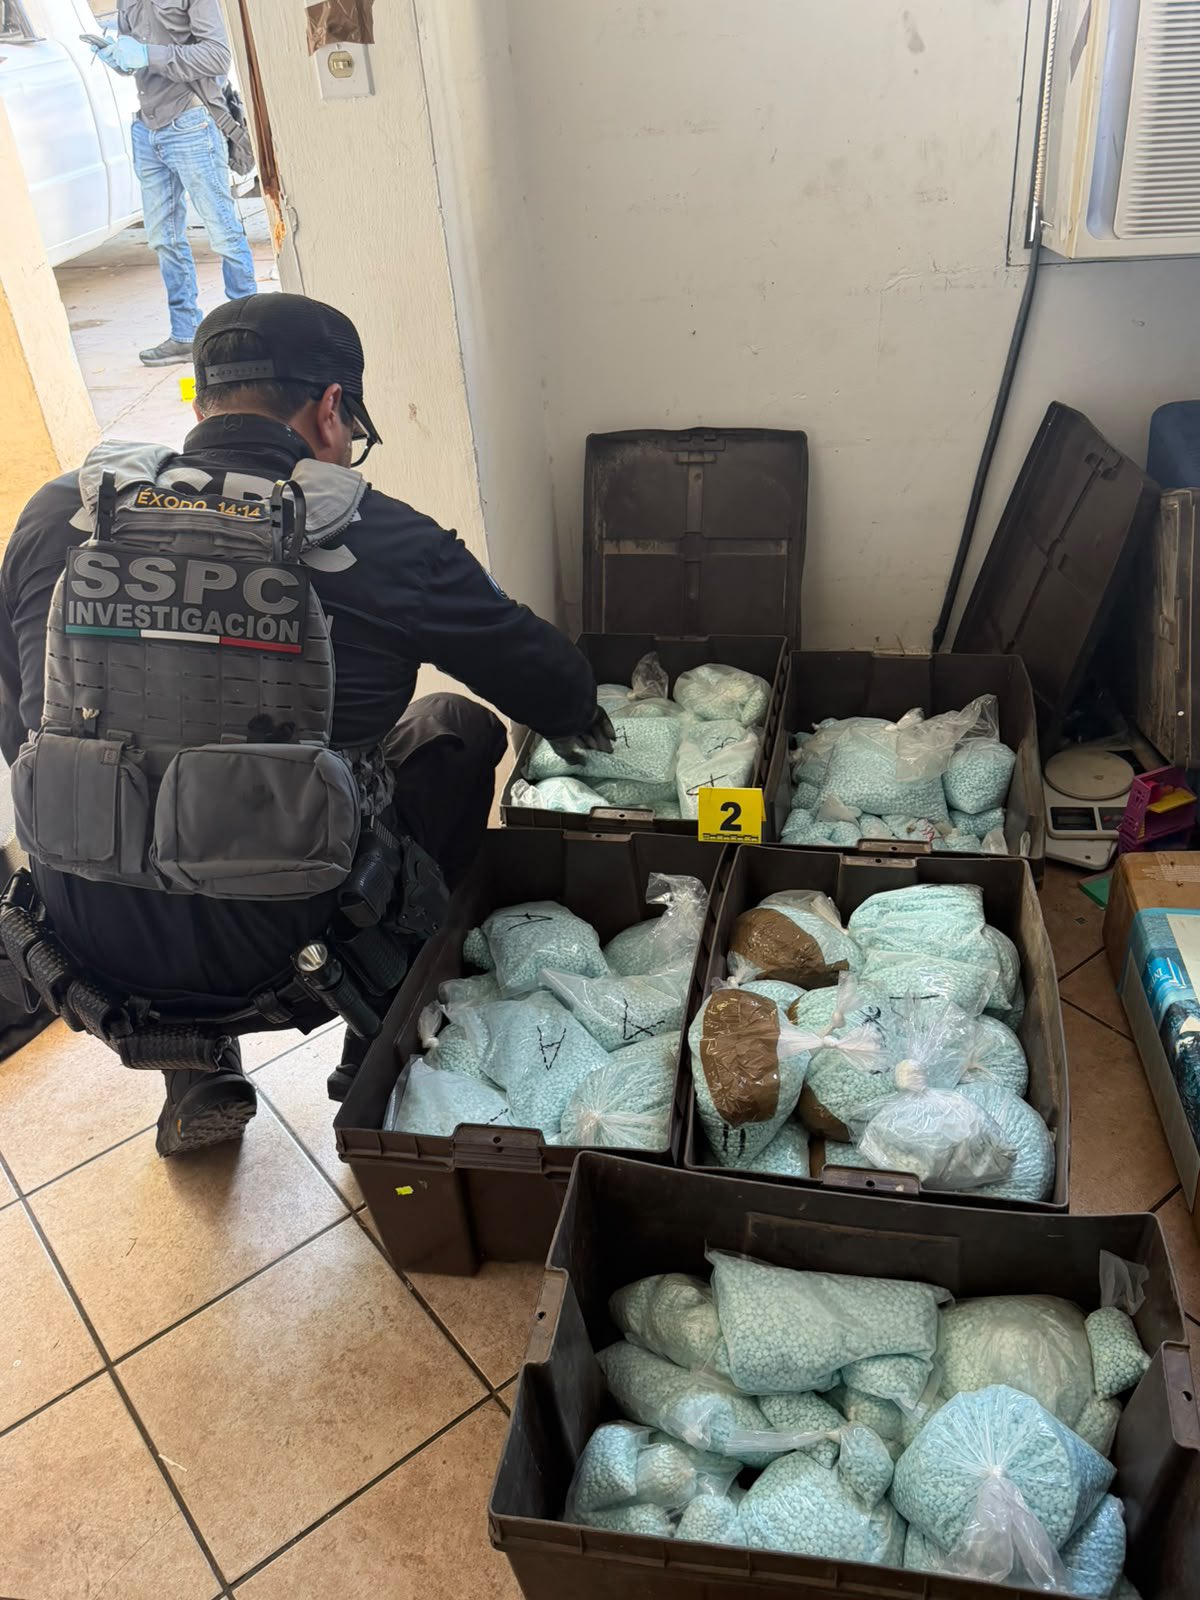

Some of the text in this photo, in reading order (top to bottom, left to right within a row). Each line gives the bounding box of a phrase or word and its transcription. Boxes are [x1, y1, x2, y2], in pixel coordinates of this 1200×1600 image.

[71, 552, 300, 615] SSPC
[68, 601, 300, 643] INVESTIGACIÓN
[720, 801, 742, 831] 2
